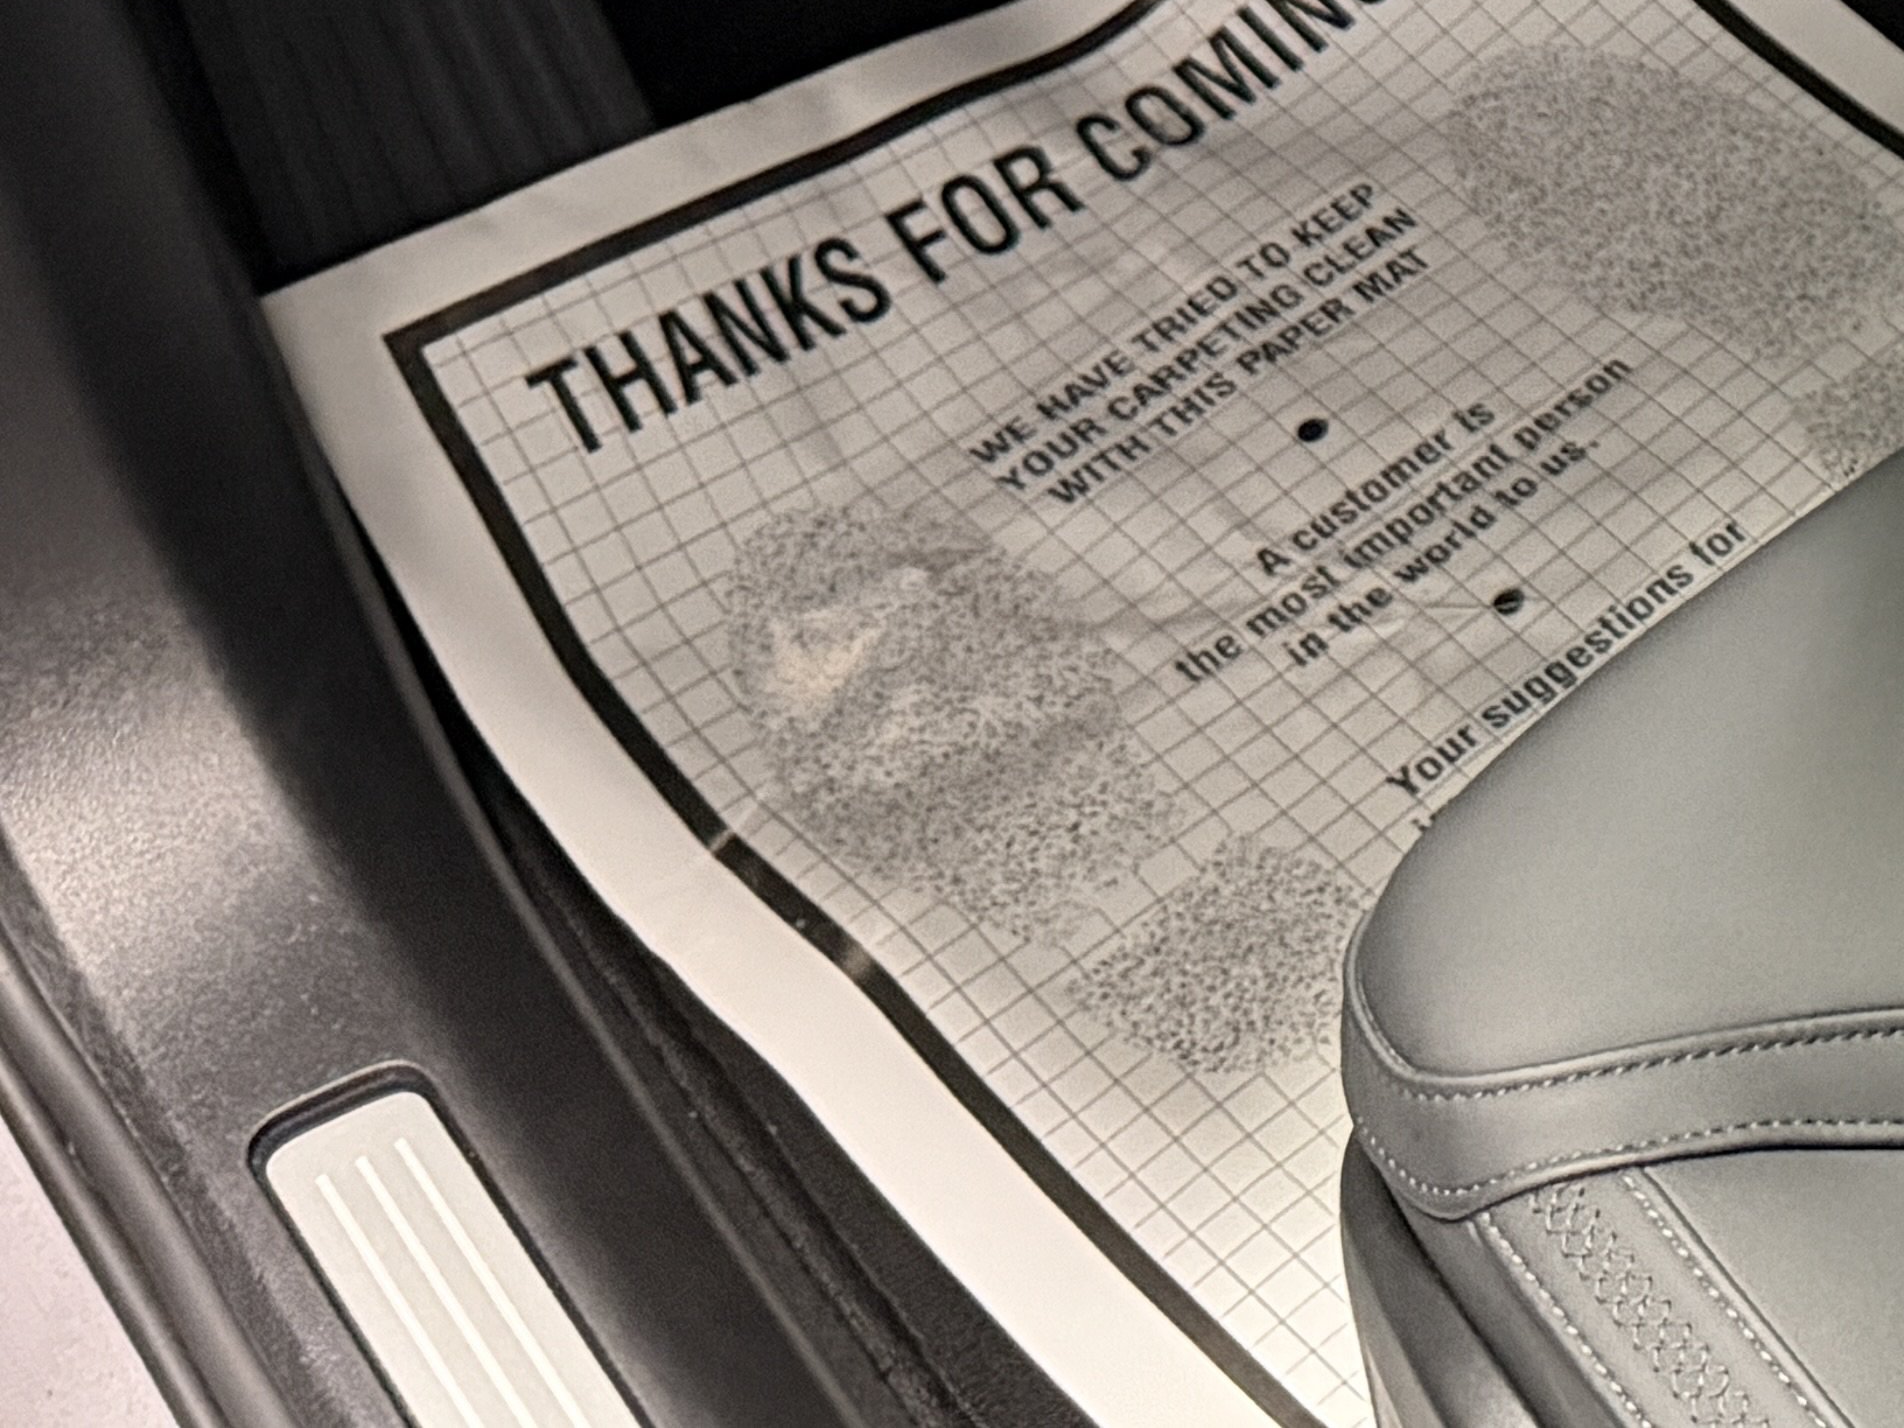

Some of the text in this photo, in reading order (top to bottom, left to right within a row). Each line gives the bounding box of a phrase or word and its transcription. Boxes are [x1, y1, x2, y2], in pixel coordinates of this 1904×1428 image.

[526, 232, 893, 454] THANKS
[885, 141, 1085, 285] FOR
[969, 181, 1376, 465] WE HAVE TRIED TO KEEP
[1000, 207, 1418, 493] YOUR CARPETING CLEAN
[1046, 246, 1430, 505] WITH THIS PAPER MAT
[1174, 356, 1632, 684] the most important person
[1256, 401, 1497, 577] A customer is
[1281, 630, 1330, 668] in
[1328, 584, 1393, 634] the
[1393, 505, 1498, 584] world
[1495, 473, 1540, 509] to
[1385, 520, 1748, 797] Your suggestions for
